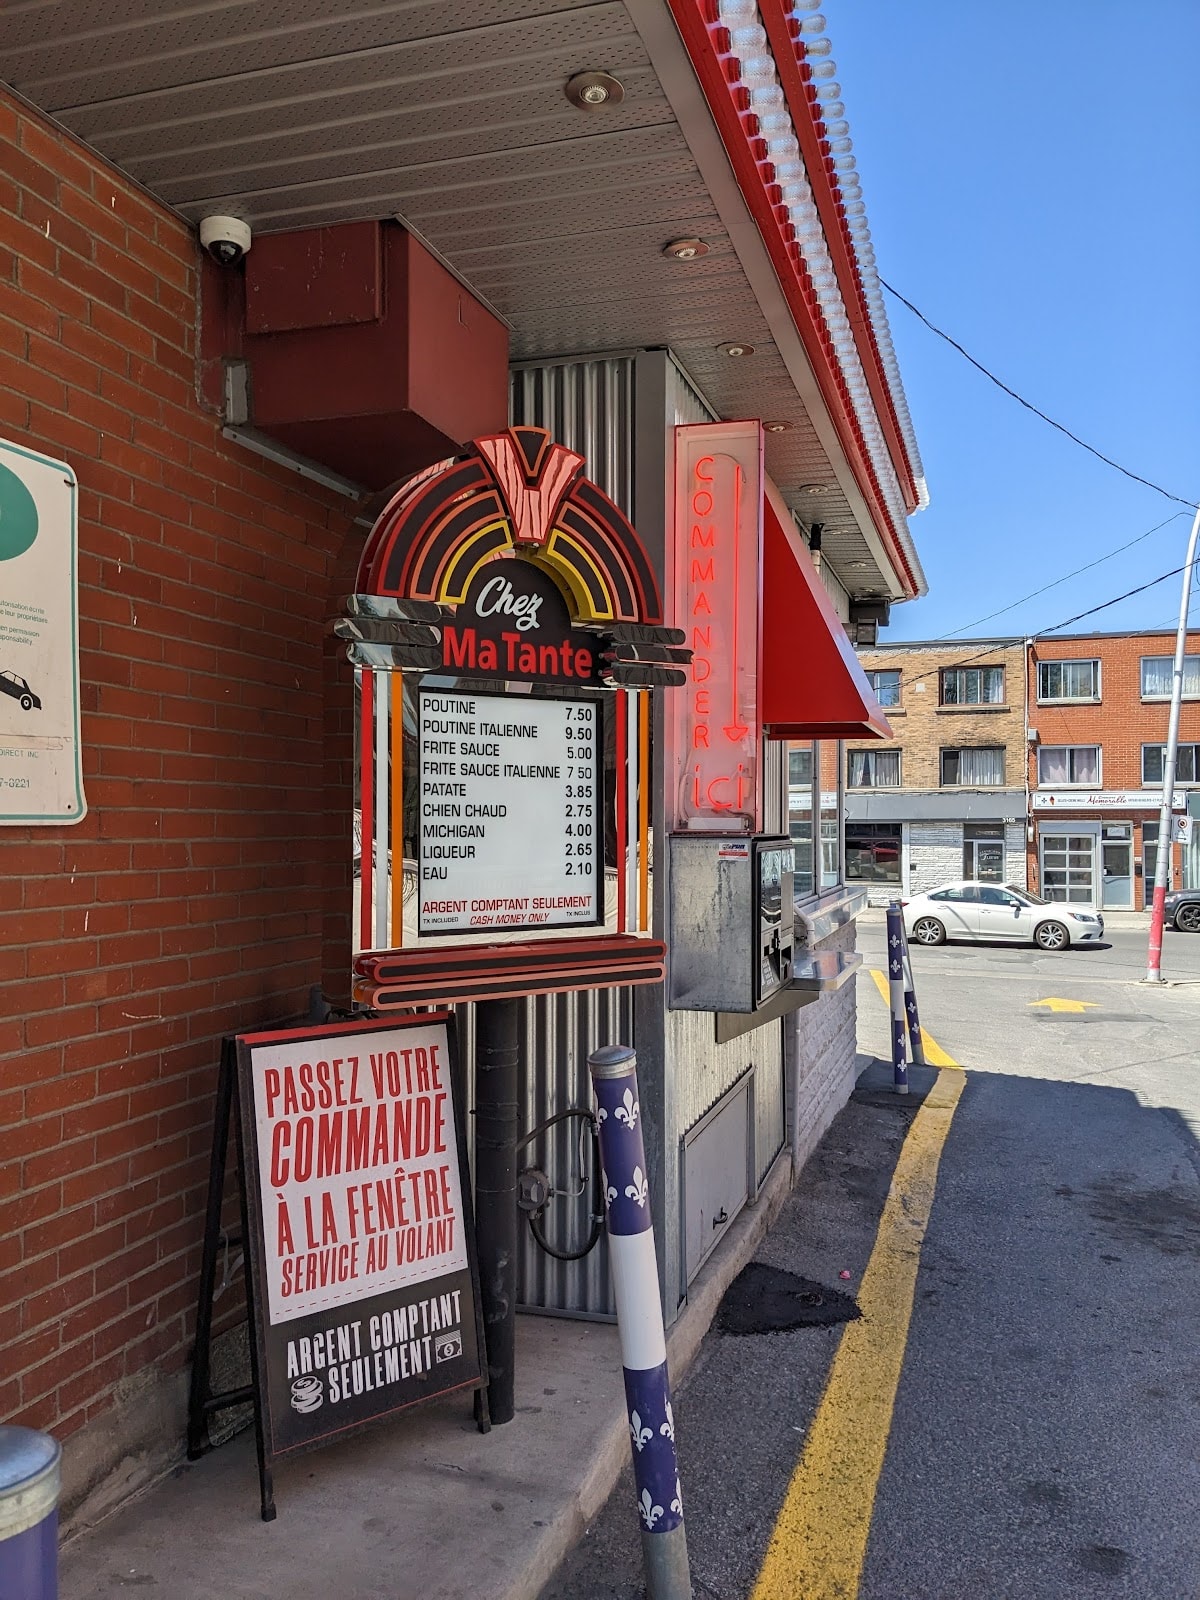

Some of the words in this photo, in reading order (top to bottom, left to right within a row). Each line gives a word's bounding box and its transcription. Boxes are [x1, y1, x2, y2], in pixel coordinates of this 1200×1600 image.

[475, 576, 544, 631] Chez
[691, 456, 715, 749] COMMANDER
[443, 625, 497, 670] Ma
[501, 631, 593, 678] Tante
[423, 699, 476, 715] POUTINE
[565, 708, 592, 721] 7.50
[423, 720, 476, 735] POUTINE
[480, 723, 538, 738] ITALIENNE
[565, 727, 592, 740] 9.50
[423, 741, 456, 755] FRITE
[460, 742, 500, 756] SAUCE
[567, 747, 592, 760] 5.00
[423, 762, 456, 776] FRITE
[460, 763, 500, 777] SAUCE
[504, 764, 560, 779] ITALIENNE
[423, 783, 467, 797] PATATE
[565, 785, 592, 798] 3.85
[423, 804, 461, 817] CHIEN
[465, 804, 507, 817] CHAUD
[565, 805, 592, 817] 2.75
[423, 825, 485, 838] MICHIGAN
[565, 824, 592, 837] 4.00
[423, 846, 476, 859] LIQUEUR
[565, 843, 592, 856] 2.65
[423, 867, 447, 880] EAU
[565, 863, 592, 876] 2.10
[422, 900, 468, 914] ARGENT
[471, 898, 529, 912] COMPTANT
[532, 896, 592, 910] SEULEMENT
[431, 916, 459, 924] INCLUDED
[470, 915, 493, 926] CASH
[496, 913, 527, 924] MONEY
[528, 912, 549, 923] ONLY
[264, 1056, 362, 1118] PASSEZ
[369, 1045, 443, 1100] VOTRE
[270, 1092, 447, 1188] COMMANDE
[277, 1192, 294, 1257] À
[304, 1191, 338, 1250] LA
[347, 1165, 454, 1239] FENÊTRE
[281, 1241, 360, 1298] SERVICE
[366, 1234, 389, 1275] AU
[396, 1216, 456, 1266] VOLANT
[287, 1320, 361, 1379] ARGENT
[369, 1290, 461, 1351] COMPTANT
[328, 1335, 432, 1404] SEULEMENT
